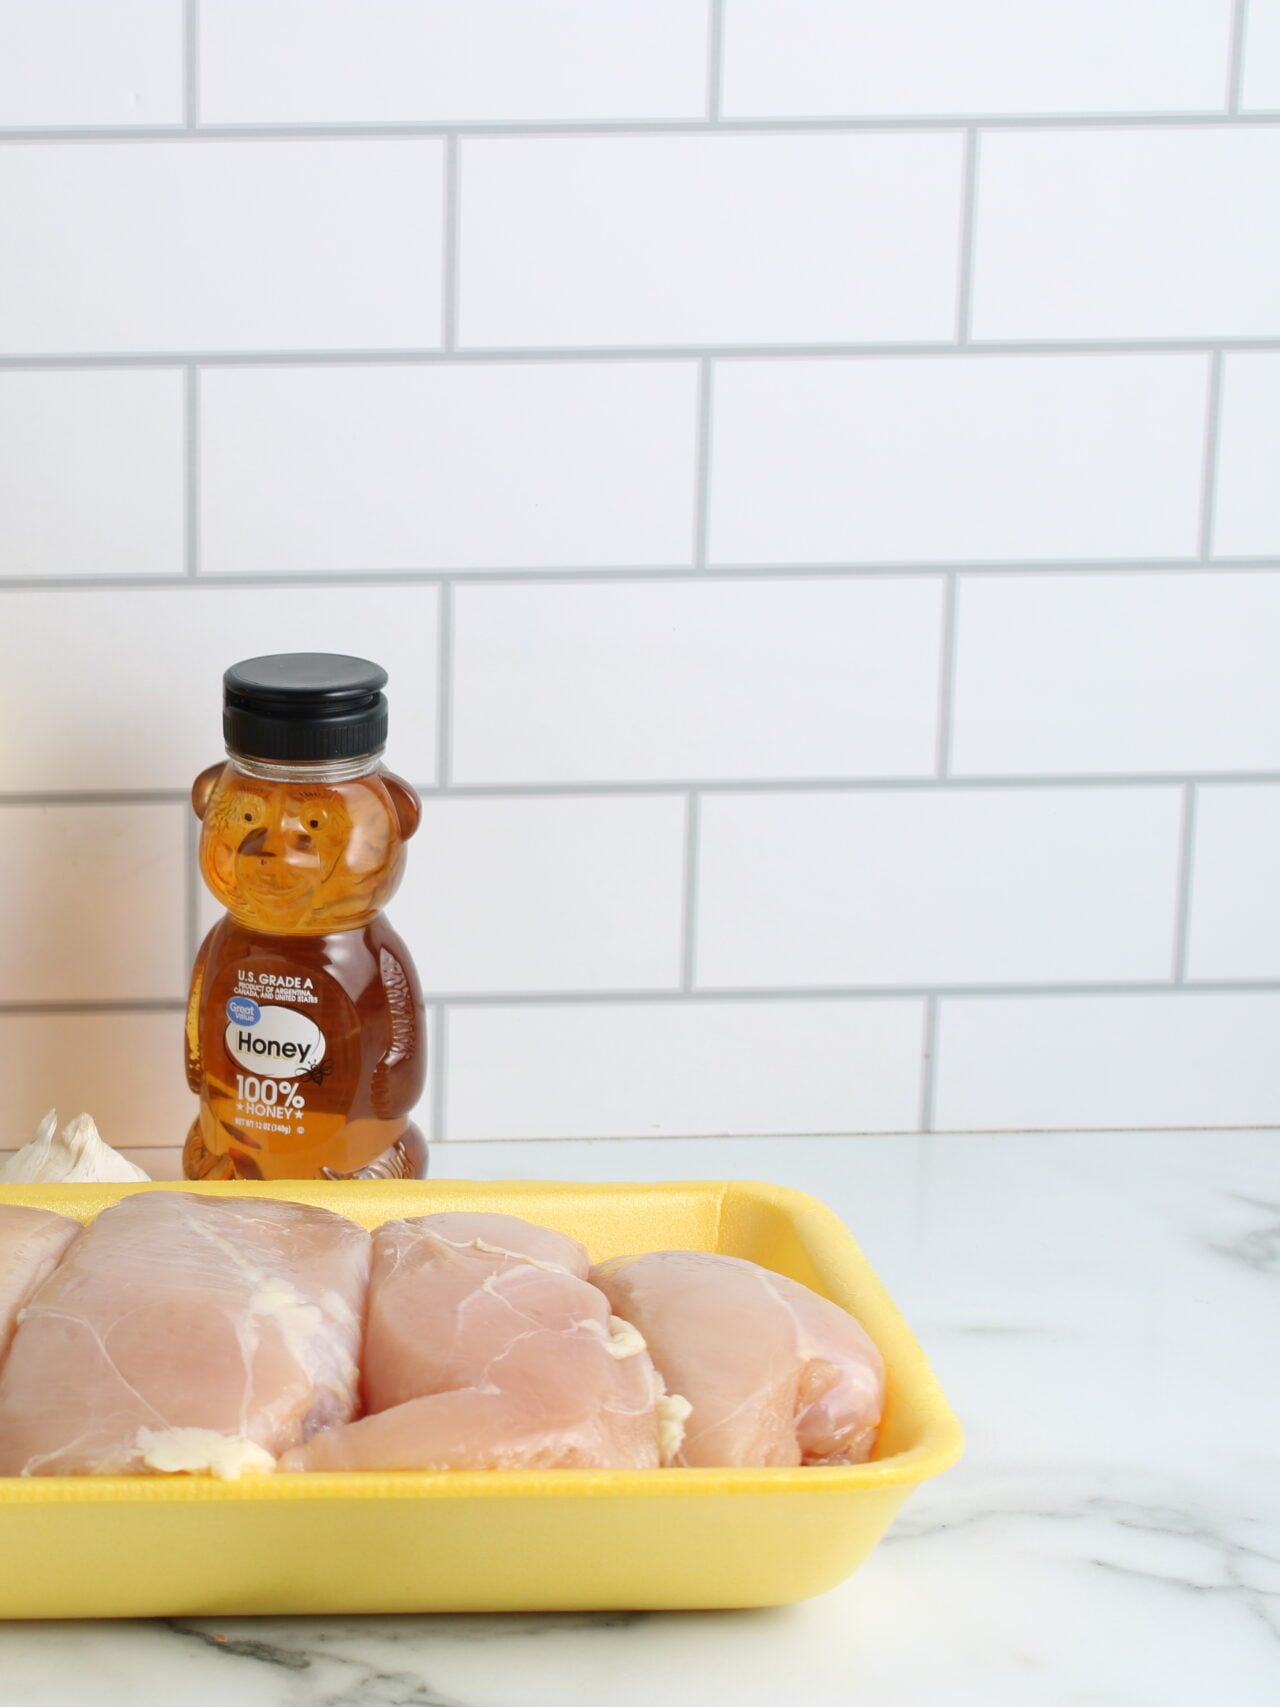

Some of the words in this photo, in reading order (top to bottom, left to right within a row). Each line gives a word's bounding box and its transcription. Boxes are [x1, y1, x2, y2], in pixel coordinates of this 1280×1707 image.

[238, 969, 256, 983] U.S.
[258, 973, 301, 989] GRADE
[303, 978, 313, 989] A
[238, 982, 264, 992] PRODUCT
[265, 986, 274, 994] OF
[260, 992, 274, 1000] AND
[274, 994, 296, 1002] UNITED
[297, 996, 319, 1004] STATES
[229, 1002, 254, 1016] Great
[235, 1012, 254, 1022] Value
[238, 1031, 311, 1063] Honey
[236, 1074, 305, 1109] 100%
[246, 1103, 293, 1120] HONEY
